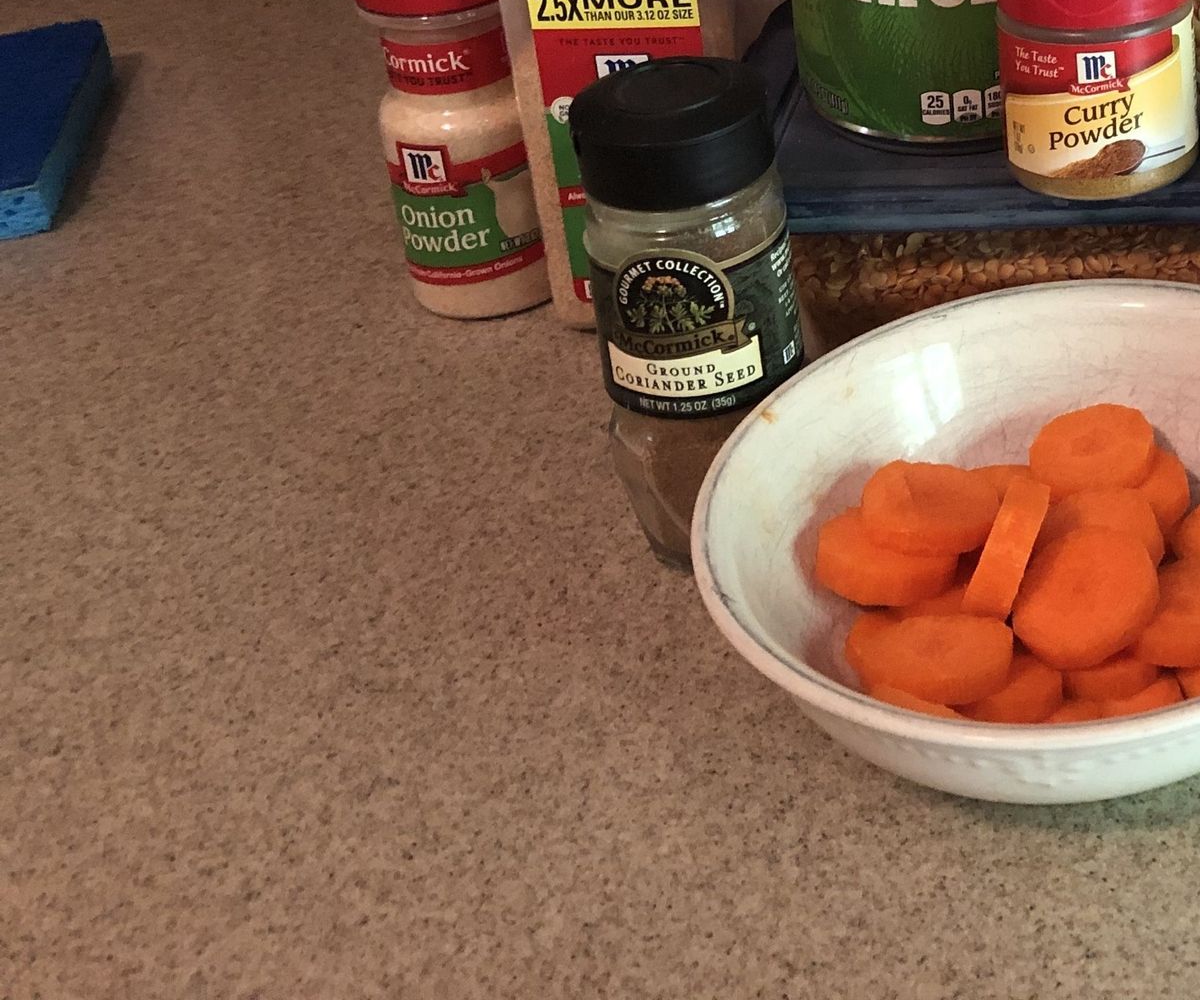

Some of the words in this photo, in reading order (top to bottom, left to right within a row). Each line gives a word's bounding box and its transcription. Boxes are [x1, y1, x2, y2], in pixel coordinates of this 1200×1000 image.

[585, 10, 611, 22] THAN
[615, 9, 635, 21] OUR
[637, 9, 655, 21] 3.12
[657, 9, 670, 20] OZ
[673, 8, 694, 20] SIZE
[559, 37, 579, 46] THE
[584, 37, 615, 46] TASTE
[620, 37, 640, 46] YOU
[645, 36, 678, 45] TRUST
[1015, 47, 1029, 60] The
[1031, 50, 1057, 65] Taste
[1015, 60, 1030, 74] You
[1070, 80, 1125, 94] McCormick
[927, 95, 944, 109] 25
[1064, 93, 1135, 126] Curry
[1049, 112, 1144, 151] Powder
[401, 205, 476, 229] Onion
[402, 226, 490, 253] Powder
[620, 261, 652, 305] GOURMET
[656, 259, 725, 303] COLLECTION
[618, 328, 724, 354] McCormick
[615, 365, 708, 392] CORIANDER
[715, 364, 756, 387] SEED
[646, 363, 716, 377] GROUND
[639, 397, 654, 408] NET
[656, 400, 670, 411] WT
[673, 401, 692, 413] 1.25
[694, 400, 708, 411] OZ
[711, 395, 736, 410] (35g)
